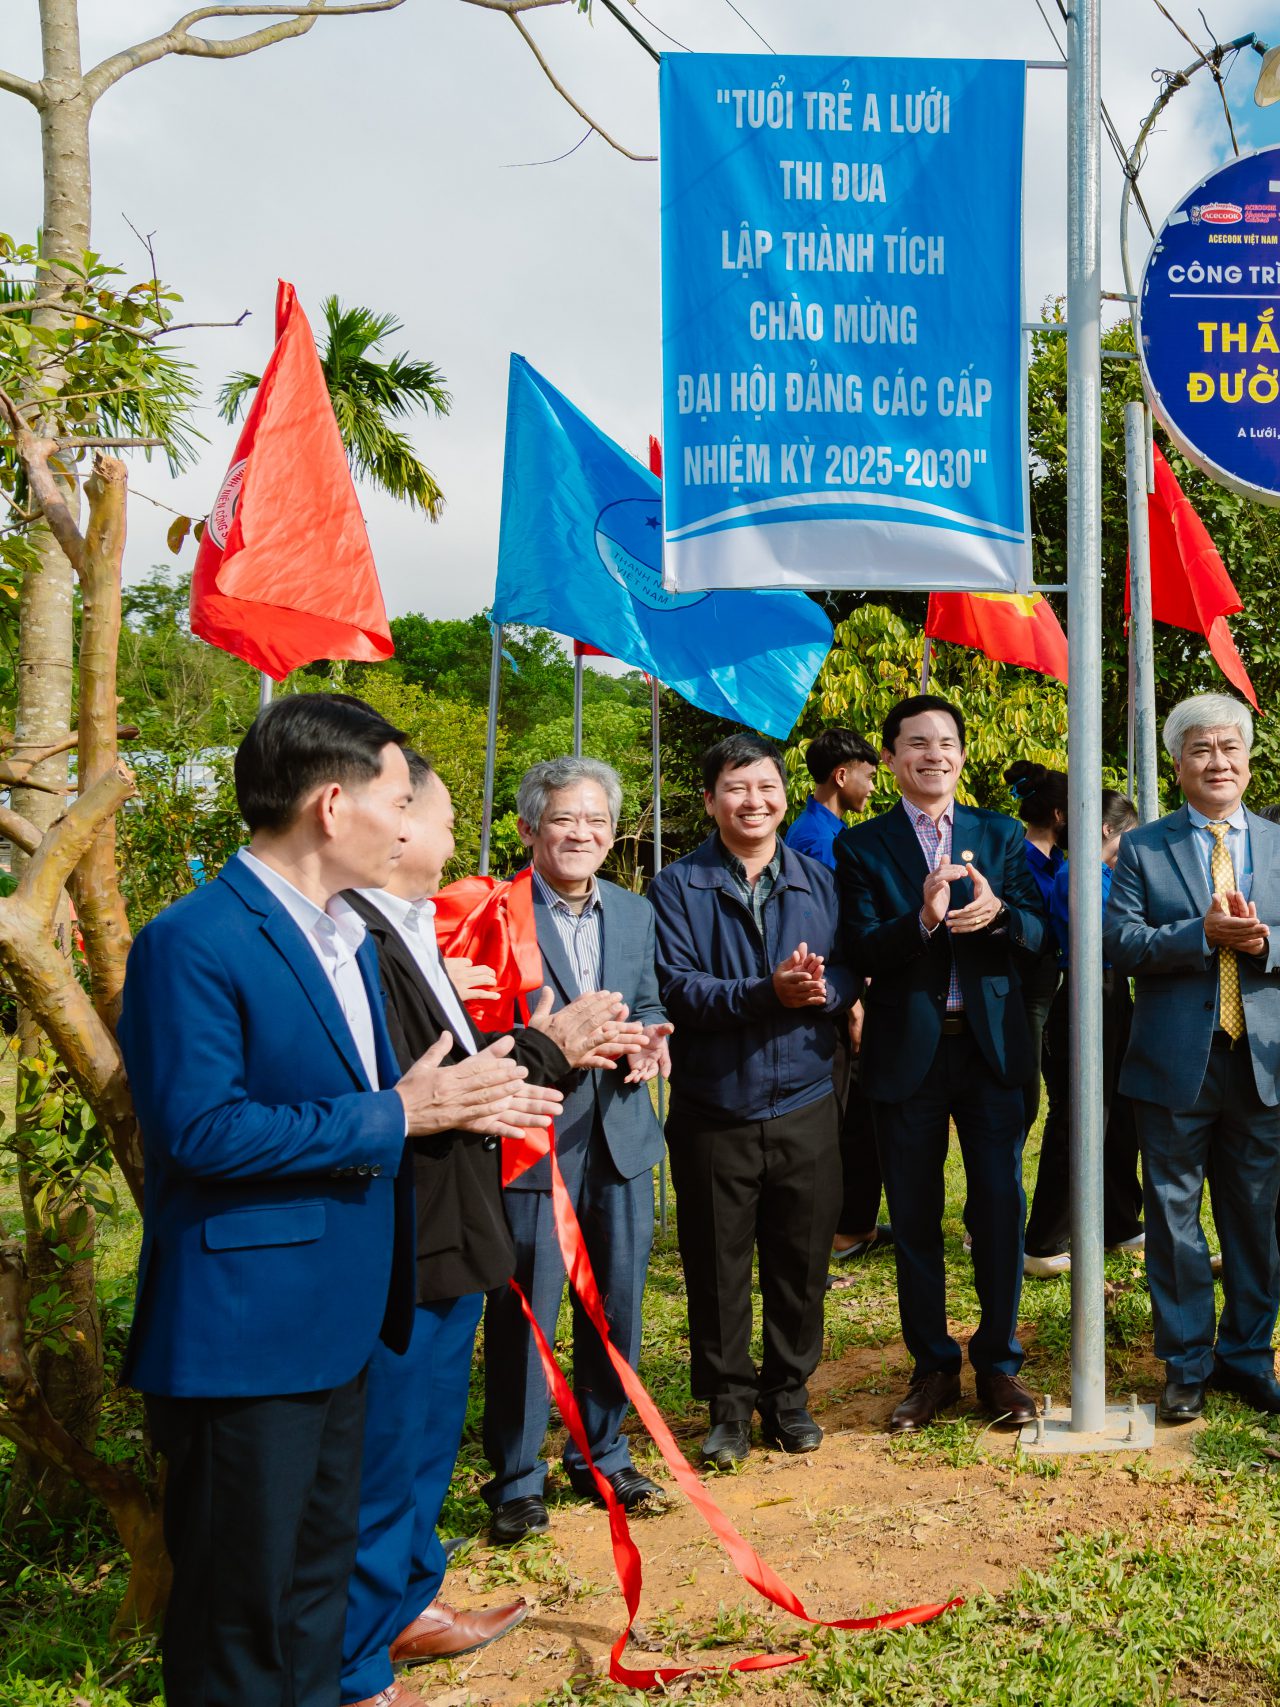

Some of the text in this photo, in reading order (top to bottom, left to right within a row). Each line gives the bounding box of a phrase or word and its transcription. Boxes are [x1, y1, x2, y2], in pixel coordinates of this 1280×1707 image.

[716, 75, 950, 134] "TUỔI TRẺ A LƯỚI
[780, 160, 886, 203] THI ĐUA
[721, 220, 945, 279] LẬP THÀNH TÍCH
[1208, 233, 1278, 246] ACECOOK VIỆT NAM
[1167, 260, 1243, 285] CÔNG
[749, 292, 918, 346] CHÀO MỪNG
[677, 358, 992, 422] ĐẠI HỘI ĐẢNG CÁC CẤP
[1237, 427, 1247, 438] A
[1250, 427, 1280, 440] Lưới,
[683, 434, 988, 492] NHIỆM KỲ 2025-2030"
[613, 551, 651, 582] THANH
[642, 585, 669, 605] NAM
